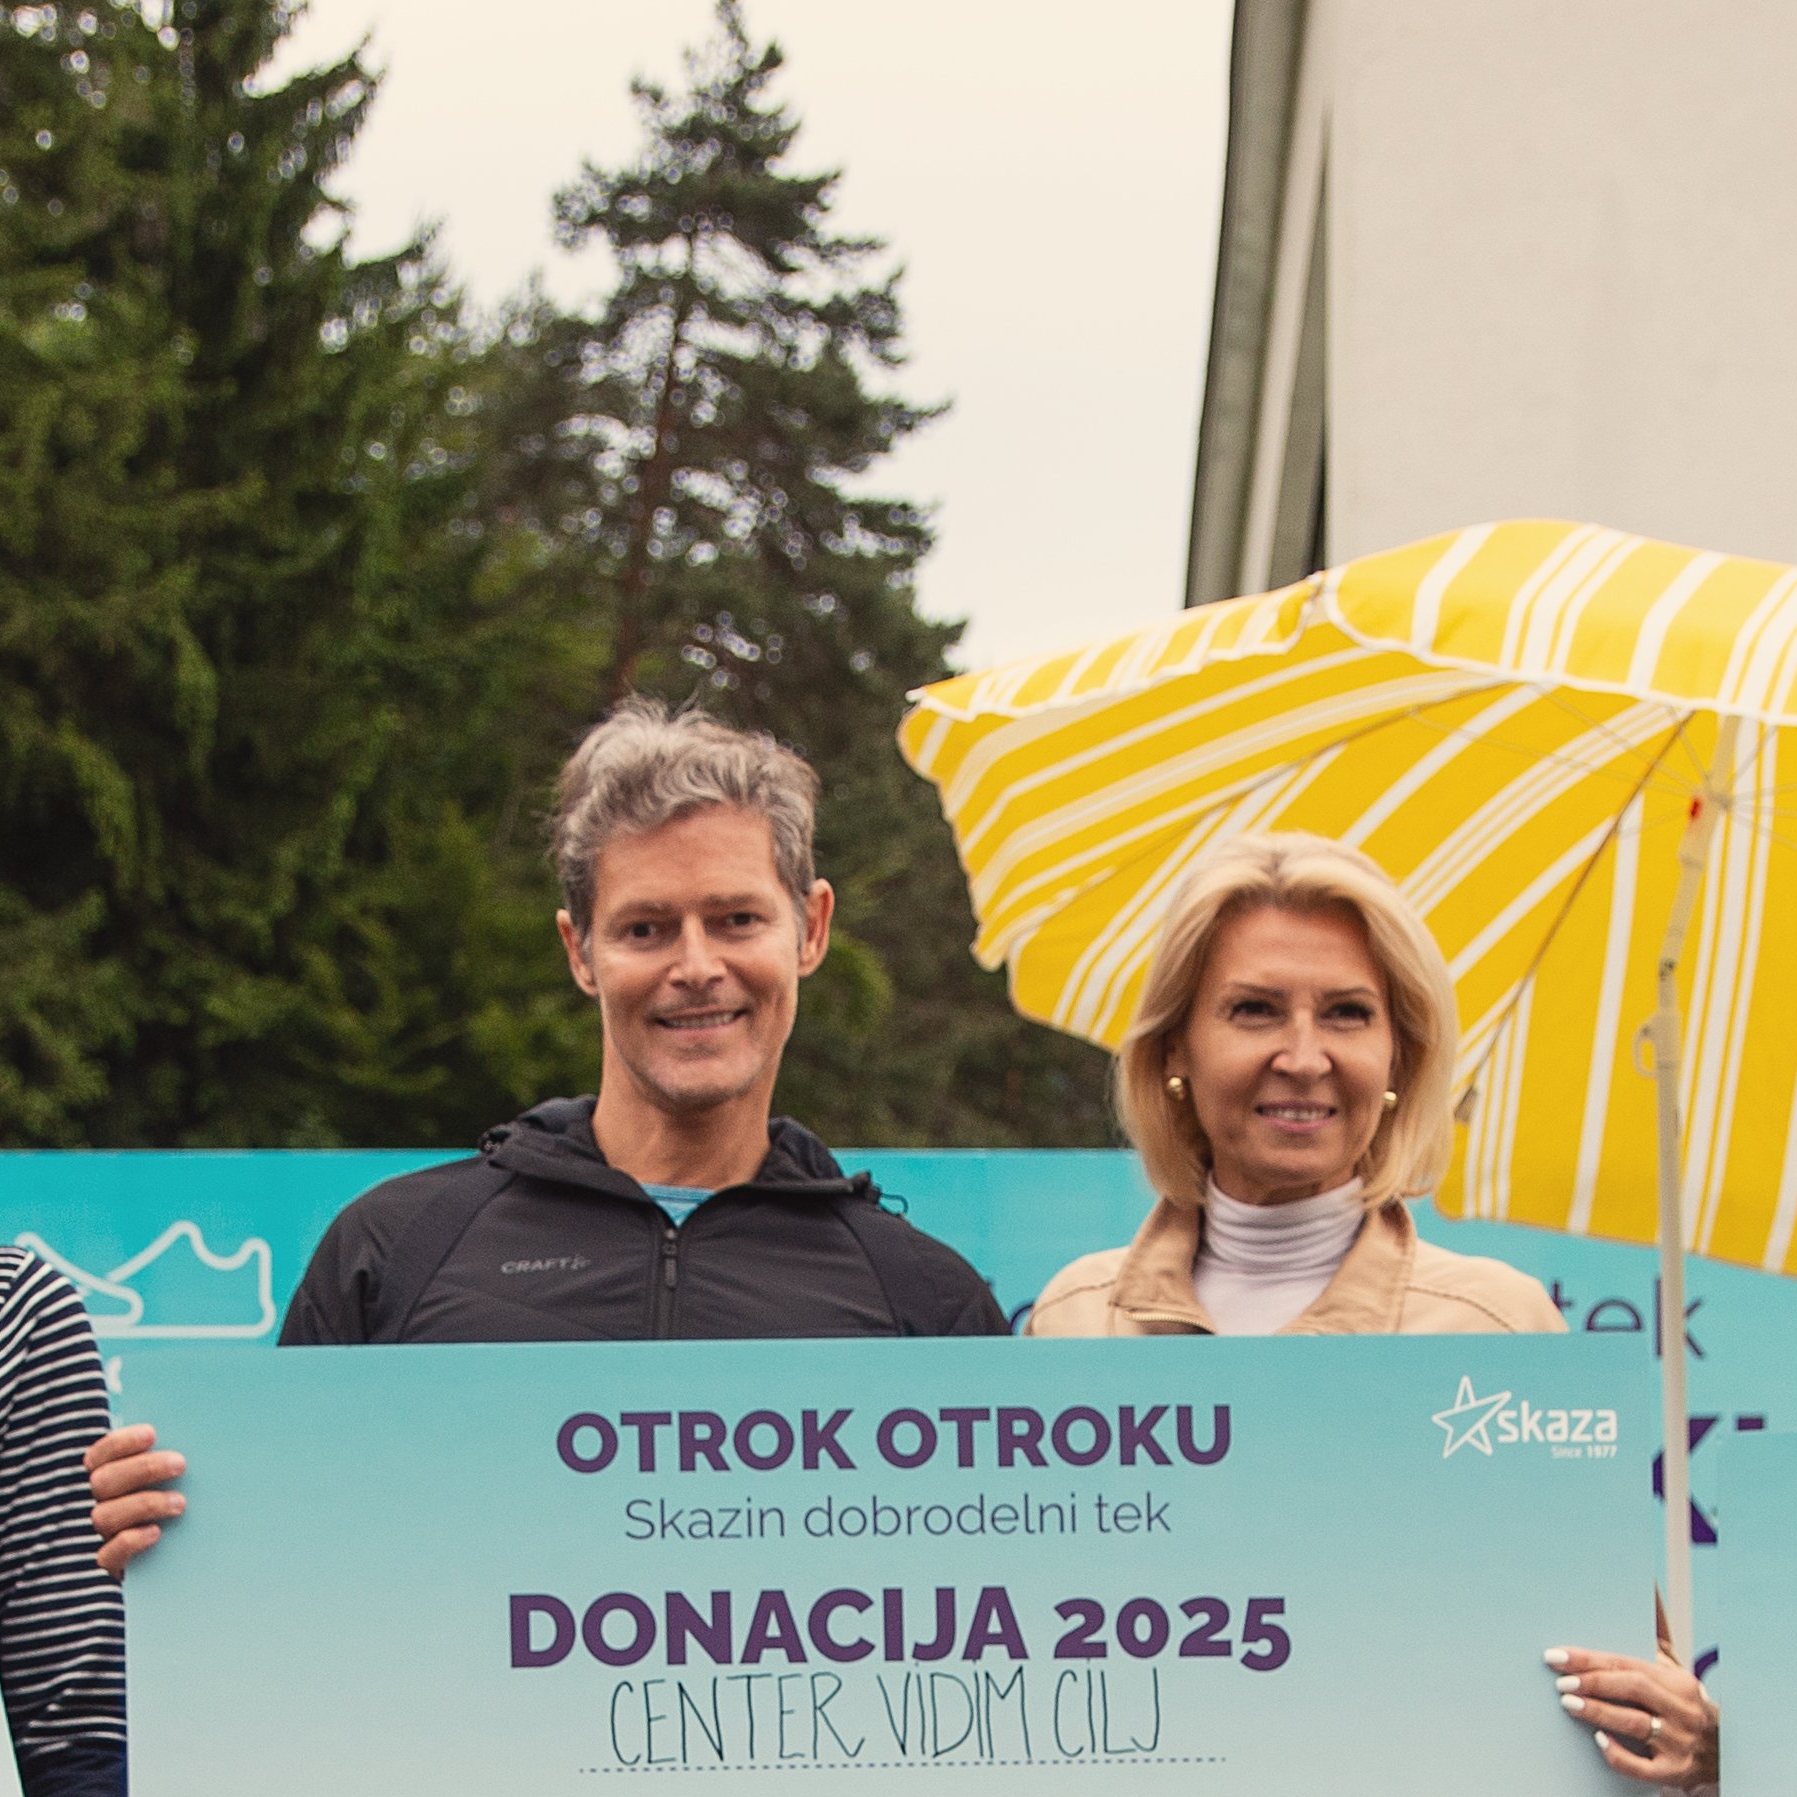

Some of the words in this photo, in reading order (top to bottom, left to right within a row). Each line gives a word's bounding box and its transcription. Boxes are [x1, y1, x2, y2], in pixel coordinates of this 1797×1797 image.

[555, 1408, 858, 1475] OTROK
[875, 1403, 1233, 1470] OTROKU
[1497, 1400, 1618, 1443] skaza
[625, 1497, 786, 1541] Skazin
[803, 1492, 1078, 1538] dobrodelni
[1094, 1490, 1172, 1534] tek
[508, 1585, 1030, 1673] DONACIJA
[1052, 1595, 1293, 1676] 2025
[610, 1671, 866, 1766] CENTER
[876, 1661, 1033, 1760] VIDIM
[1053, 1660, 1161, 1758] CILJ
